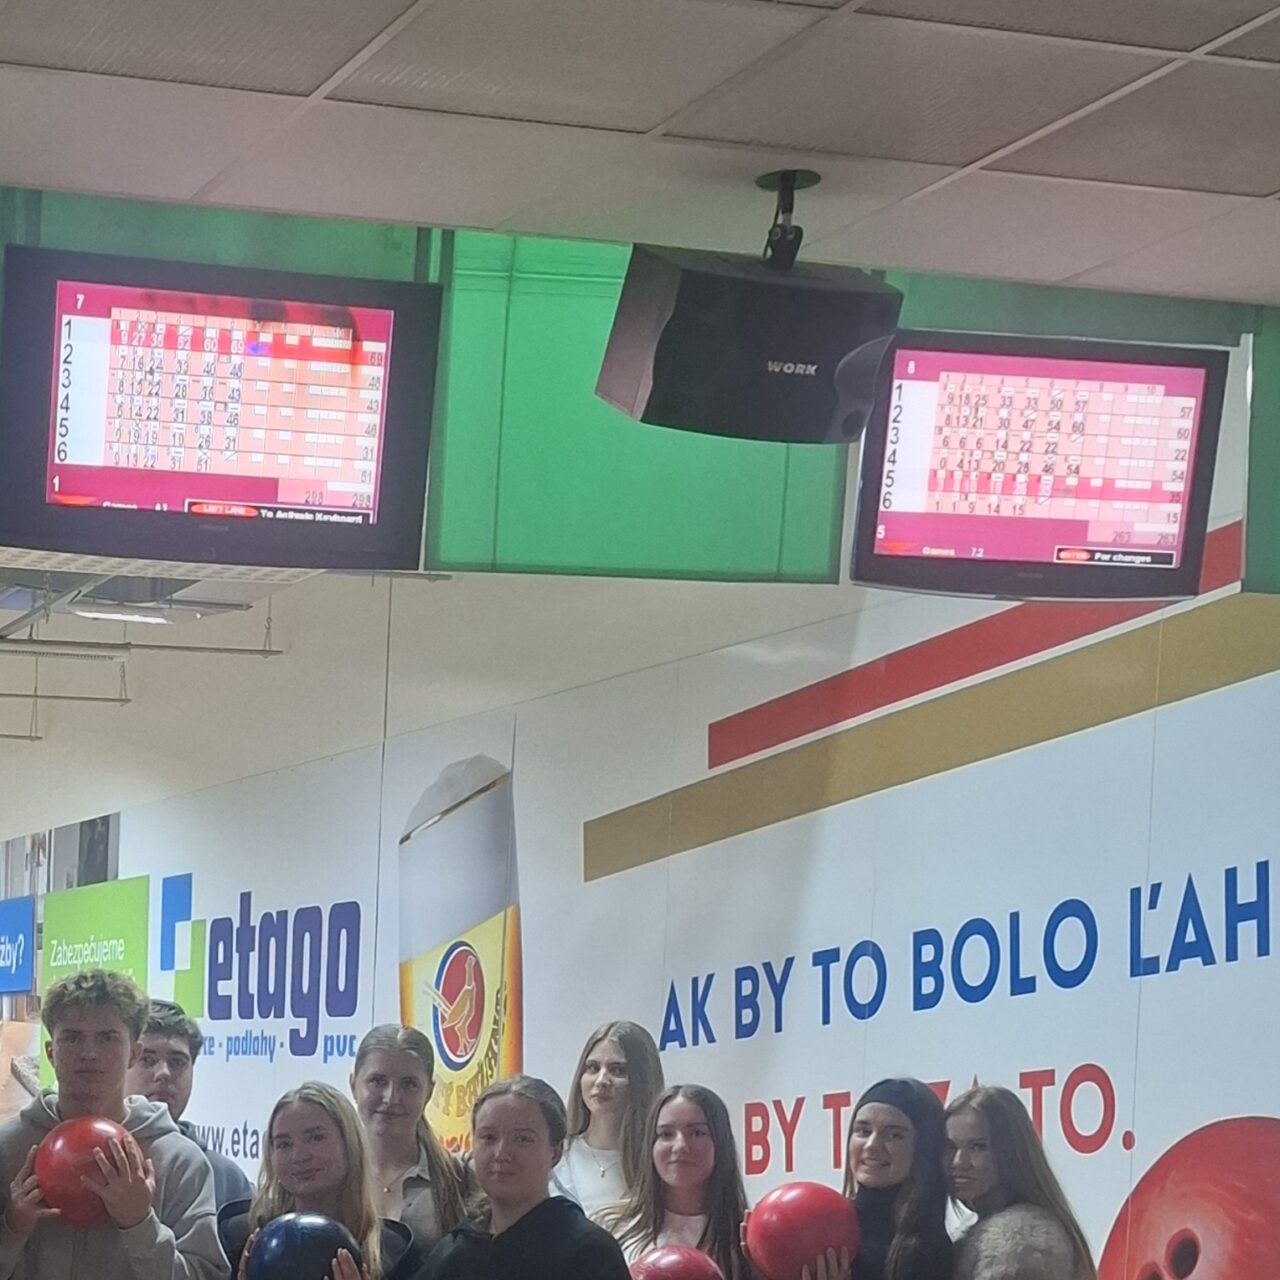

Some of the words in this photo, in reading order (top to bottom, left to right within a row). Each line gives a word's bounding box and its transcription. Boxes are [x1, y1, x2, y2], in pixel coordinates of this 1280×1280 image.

[76, 294, 85, 310] 7
[64, 319, 72, 340] 1
[132, 332, 146, 345] 27
[62, 344, 73, 365] 2
[767, 360, 819, 376] WORK
[907, 361, 915, 374] 8
[61, 369, 72, 389] 3
[60, 393, 70, 414] 4
[895, 383, 903, 401] 1
[947, 392, 953, 404] 9
[959, 394, 970, 406] 18
[1050, 400, 1063, 412] 50
[1075, 400, 1088, 412] 57
[1180, 406, 1193, 418] 57
[58, 417, 69, 438] 5
[892, 405, 903, 423] 2
[956, 415, 969, 427] 13
[1022, 419, 1036, 430] 47
[1048, 420, 1061, 431] 54
[1072, 422, 1085, 433] 60
[1177, 428, 1189, 439] 60
[57, 442, 67, 462] 6
[889, 427, 900, 445] 3
[942, 436, 949, 447] 6
[959, 436, 966, 448] 6
[995, 440, 1008, 450] 14
[1020, 441, 1032, 452] 22
[1045, 442, 1057, 454] 22
[1174, 449, 1187, 461] 22
[887, 448, 897, 466] 4
[957, 458, 964, 469] 4
[992, 460, 1005, 473] 20
[1017, 461, 1030, 474] 28
[1042, 463, 1055, 474] 46
[1066, 465, 1080, 476] 54
[1172, 471, 1184, 482] 54
[52, 475, 60, 492] 1
[885, 470, 895, 488] 5
[882, 491, 892, 509] 6
[988, 503, 1000, 514] 14
[1012, 505, 1025, 516] 15
[876, 525, 885, 539] 5
[208, 891, 361, 1057] etago
[658, 972, 717, 1052] AK
[733, 955, 796, 1041] BY
[811, 939, 888, 1027] TO
[912, 898, 1099, 1013] BOLO
[226, 1030, 276, 1063] podlahy
[323, 1034, 357, 1064] pvc
[744, 1094, 806, 1177] BY
[1020, 1063, 1136, 1156] TO.
